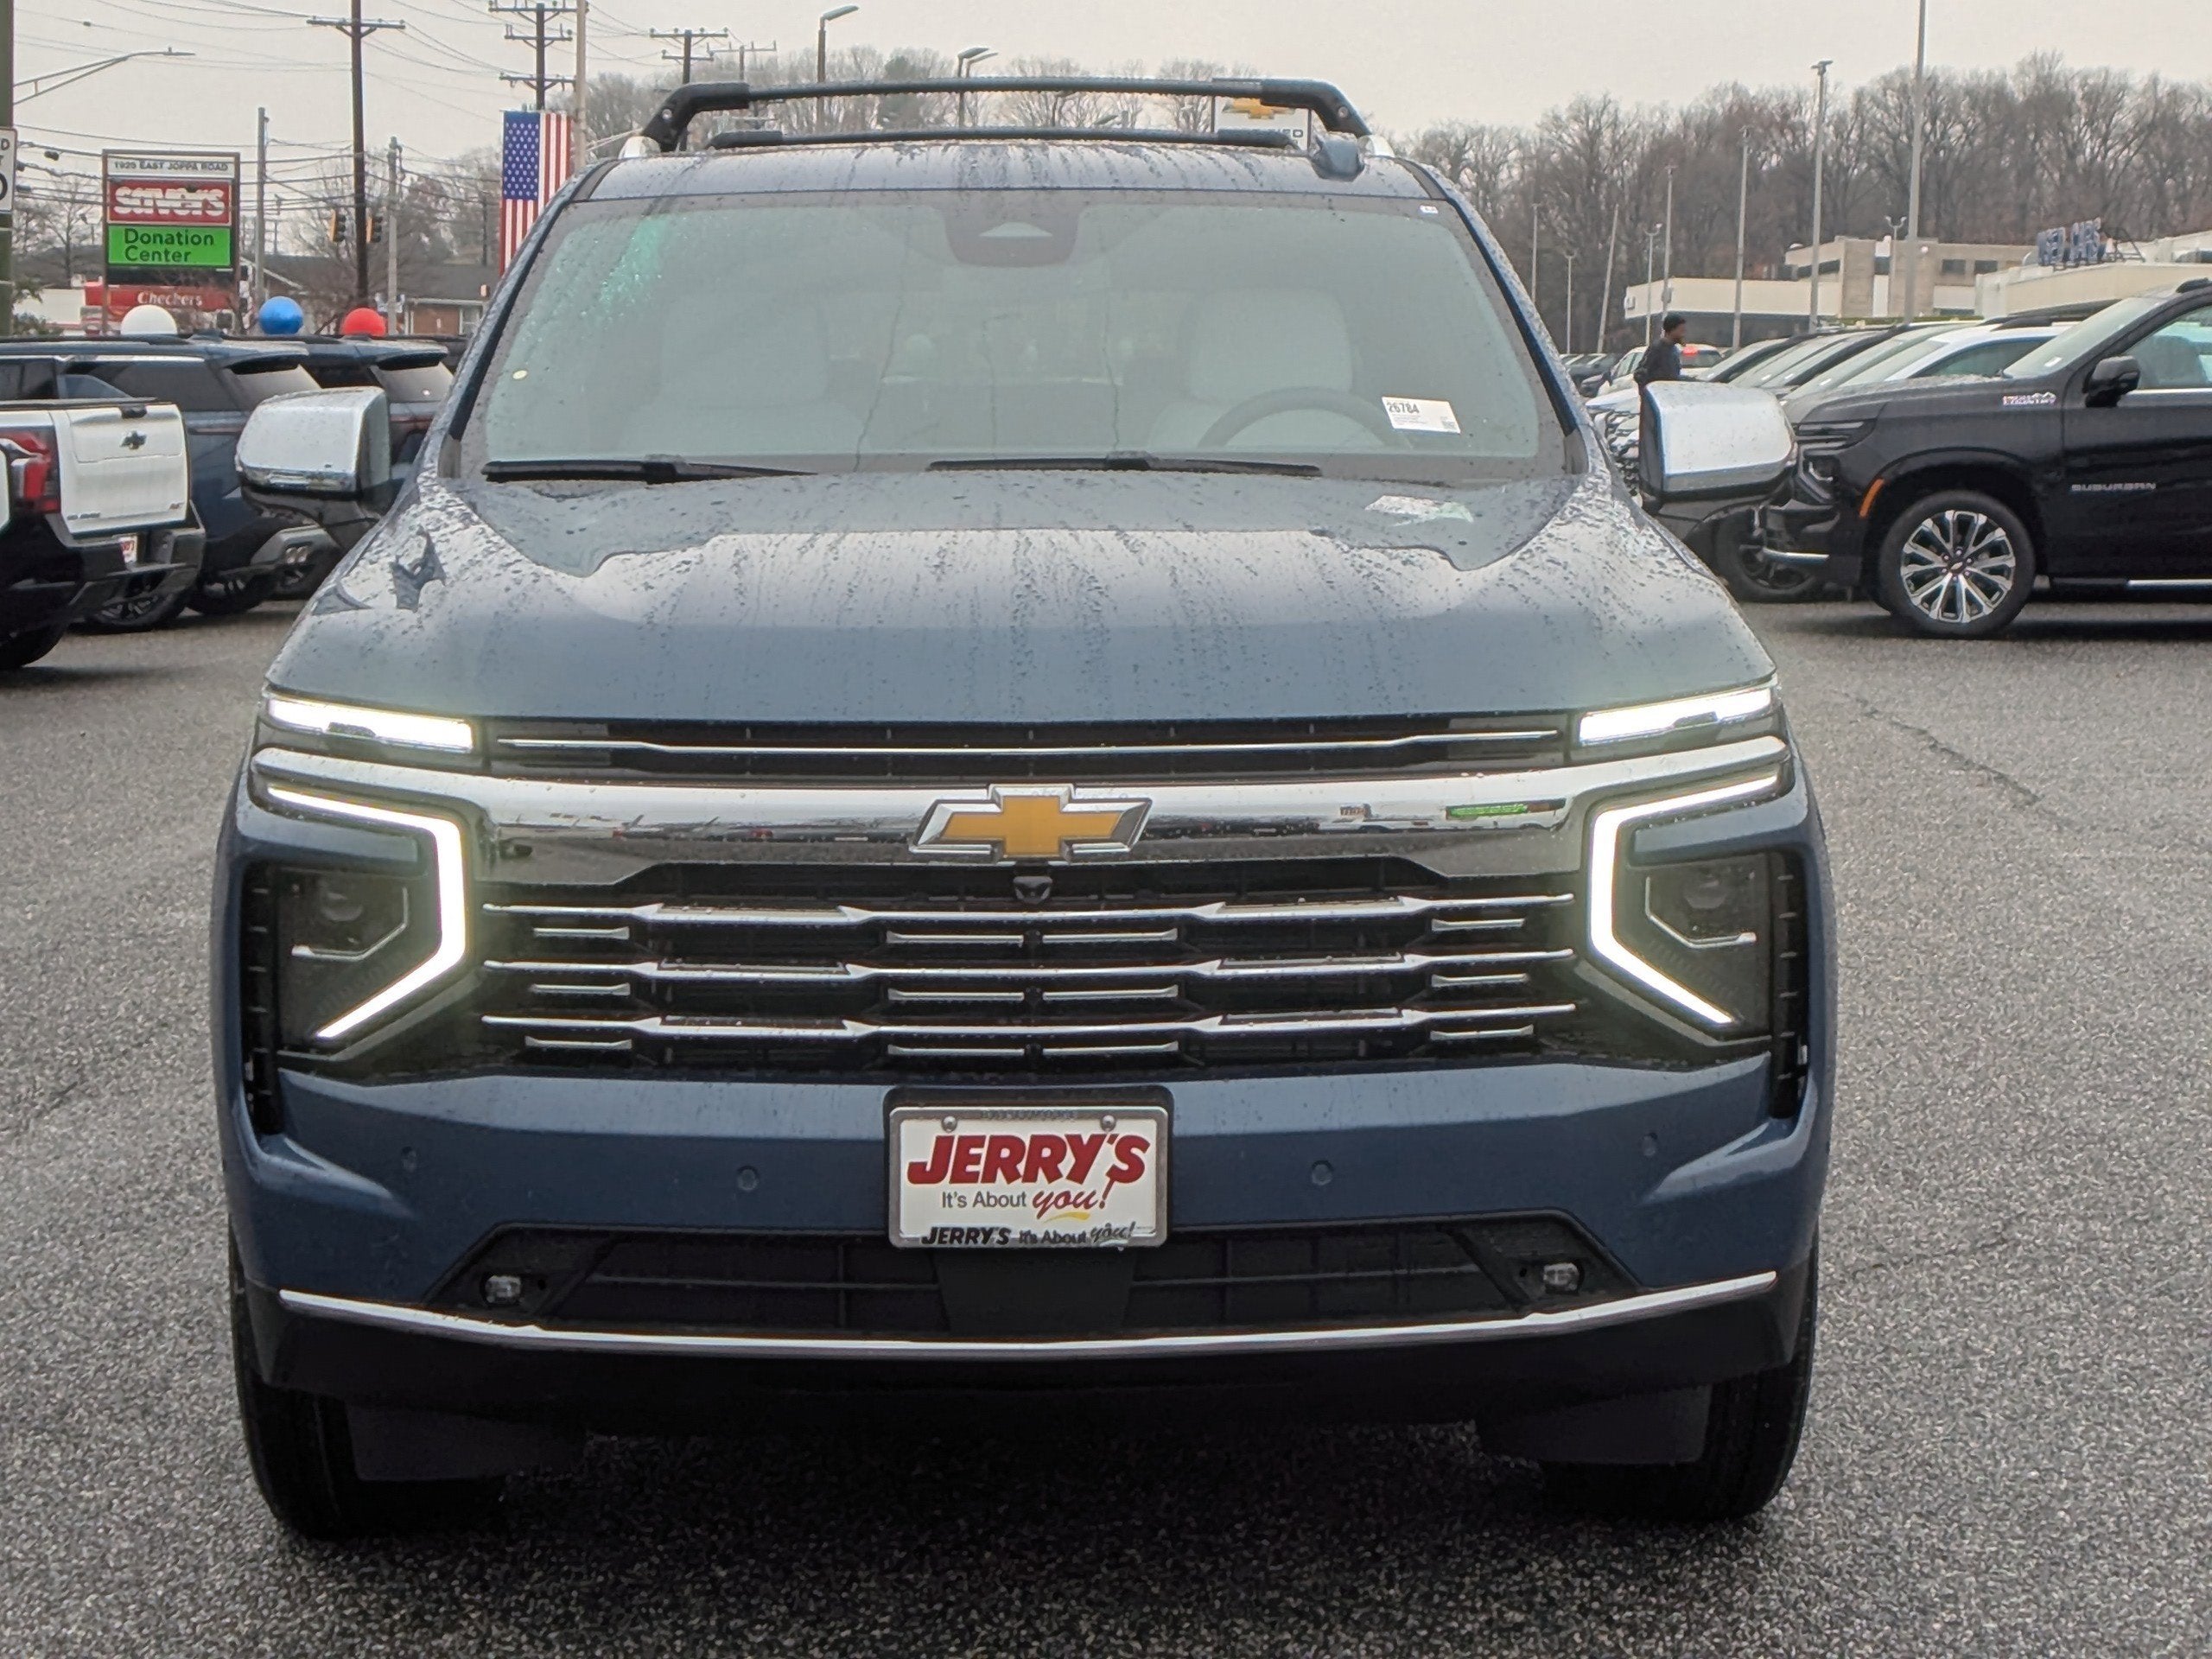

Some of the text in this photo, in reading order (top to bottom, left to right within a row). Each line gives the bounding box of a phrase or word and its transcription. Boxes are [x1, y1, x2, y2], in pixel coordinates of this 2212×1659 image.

[139, 161, 165, 170] EAST
[168, 162, 199, 171] JOPPA
[201, 162, 229, 171] ROAD
[124, 228, 214, 245] Donation
[124, 245, 191, 262] Center
[137, 290, 203, 307] Checkers
[2072, 483, 2156, 492] SUBURBAN
[907, 1134, 1151, 1185] JERRY'S
[942, 1175, 1117, 1220] It's About you!
[921, 1226, 1012, 1245] JERRY'S
[1019, 1230, 1038, 1244] It's
[1043, 1230, 1087, 1243] About
